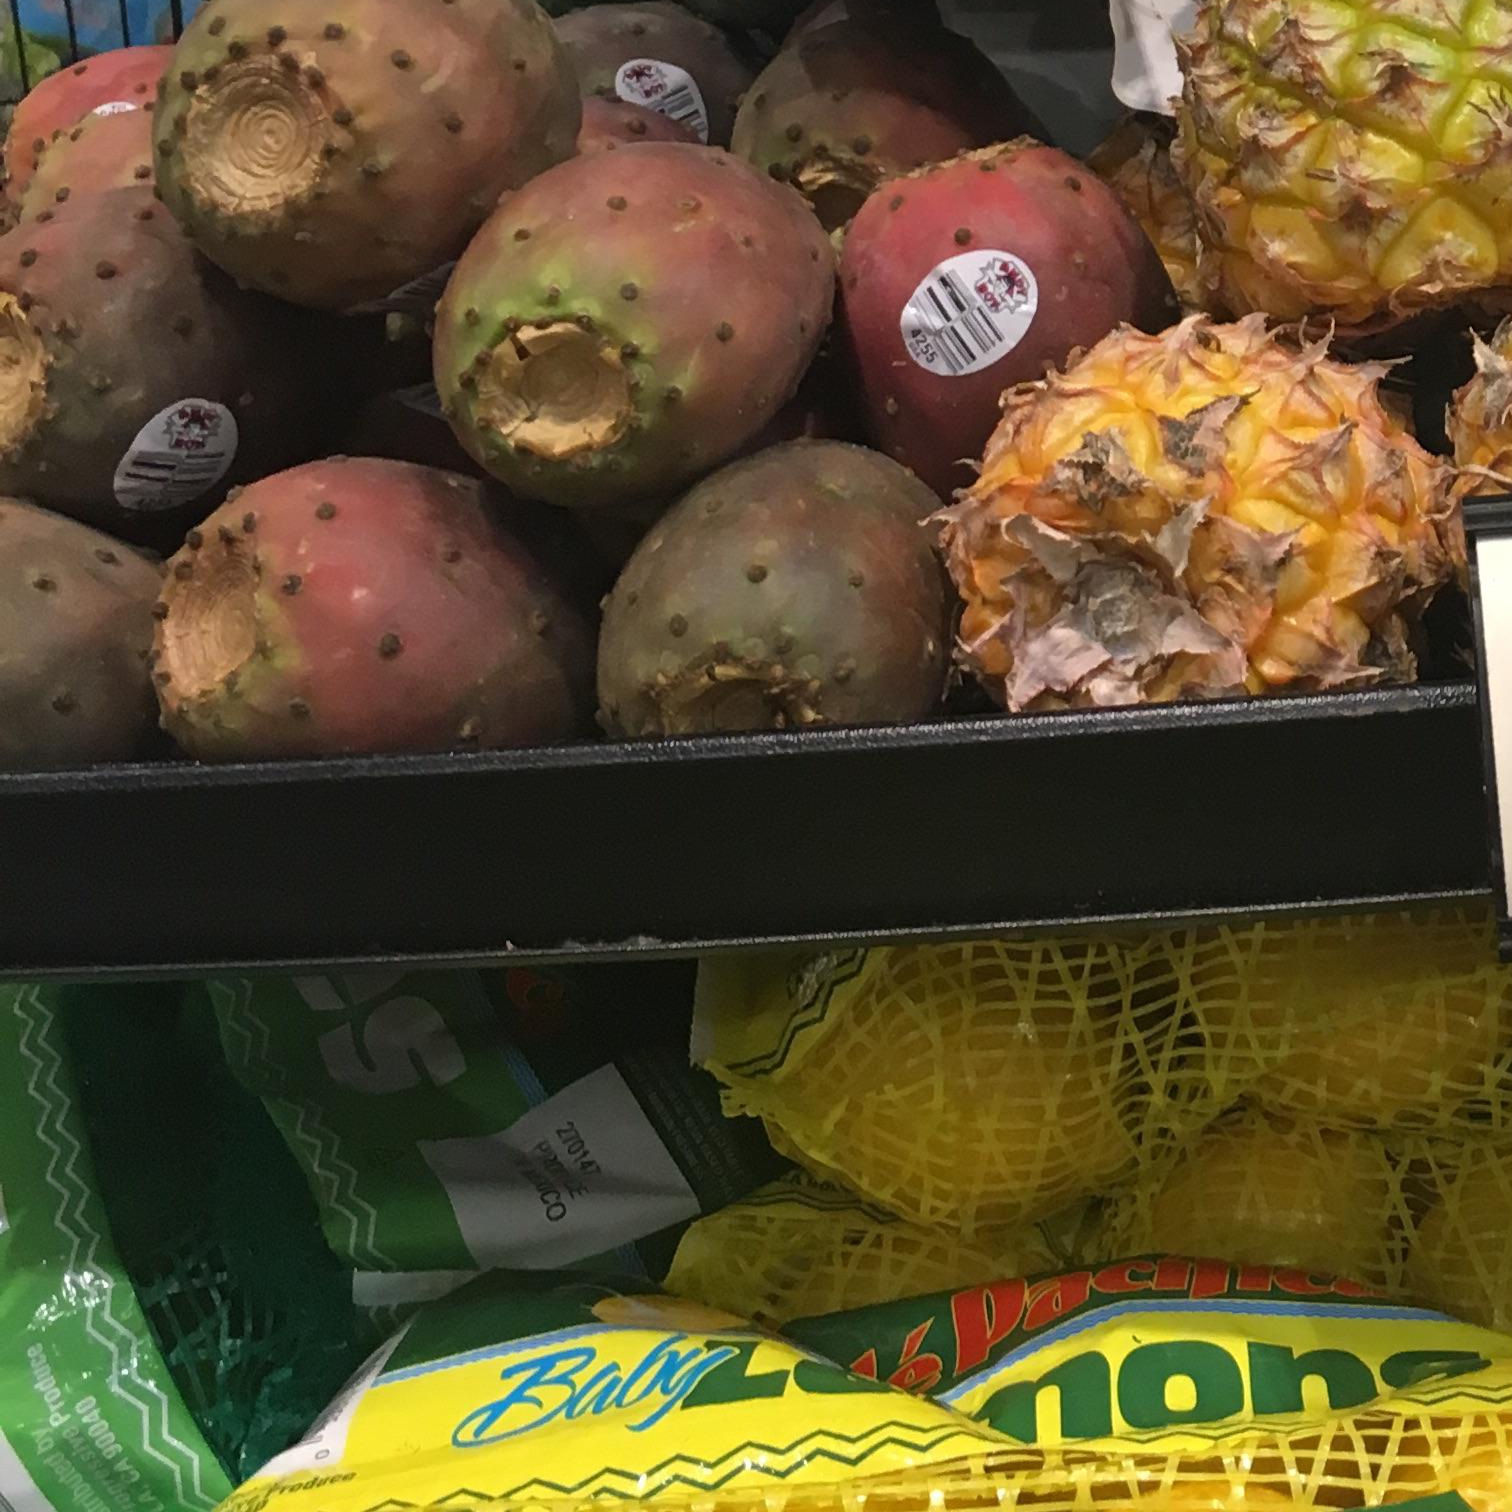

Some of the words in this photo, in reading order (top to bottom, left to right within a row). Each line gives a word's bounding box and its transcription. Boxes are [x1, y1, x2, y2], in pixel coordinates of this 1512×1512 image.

[910, 328, 939, 364] 4255
[27, 1343, 72, 1428] Produce
[451, 1331, 740, 1449] Baby
[75, 1395, 123, 1460] 90040
[43, 1450, 112, 1512] tributed
[62, 1426, 135, 1512] rogressive
